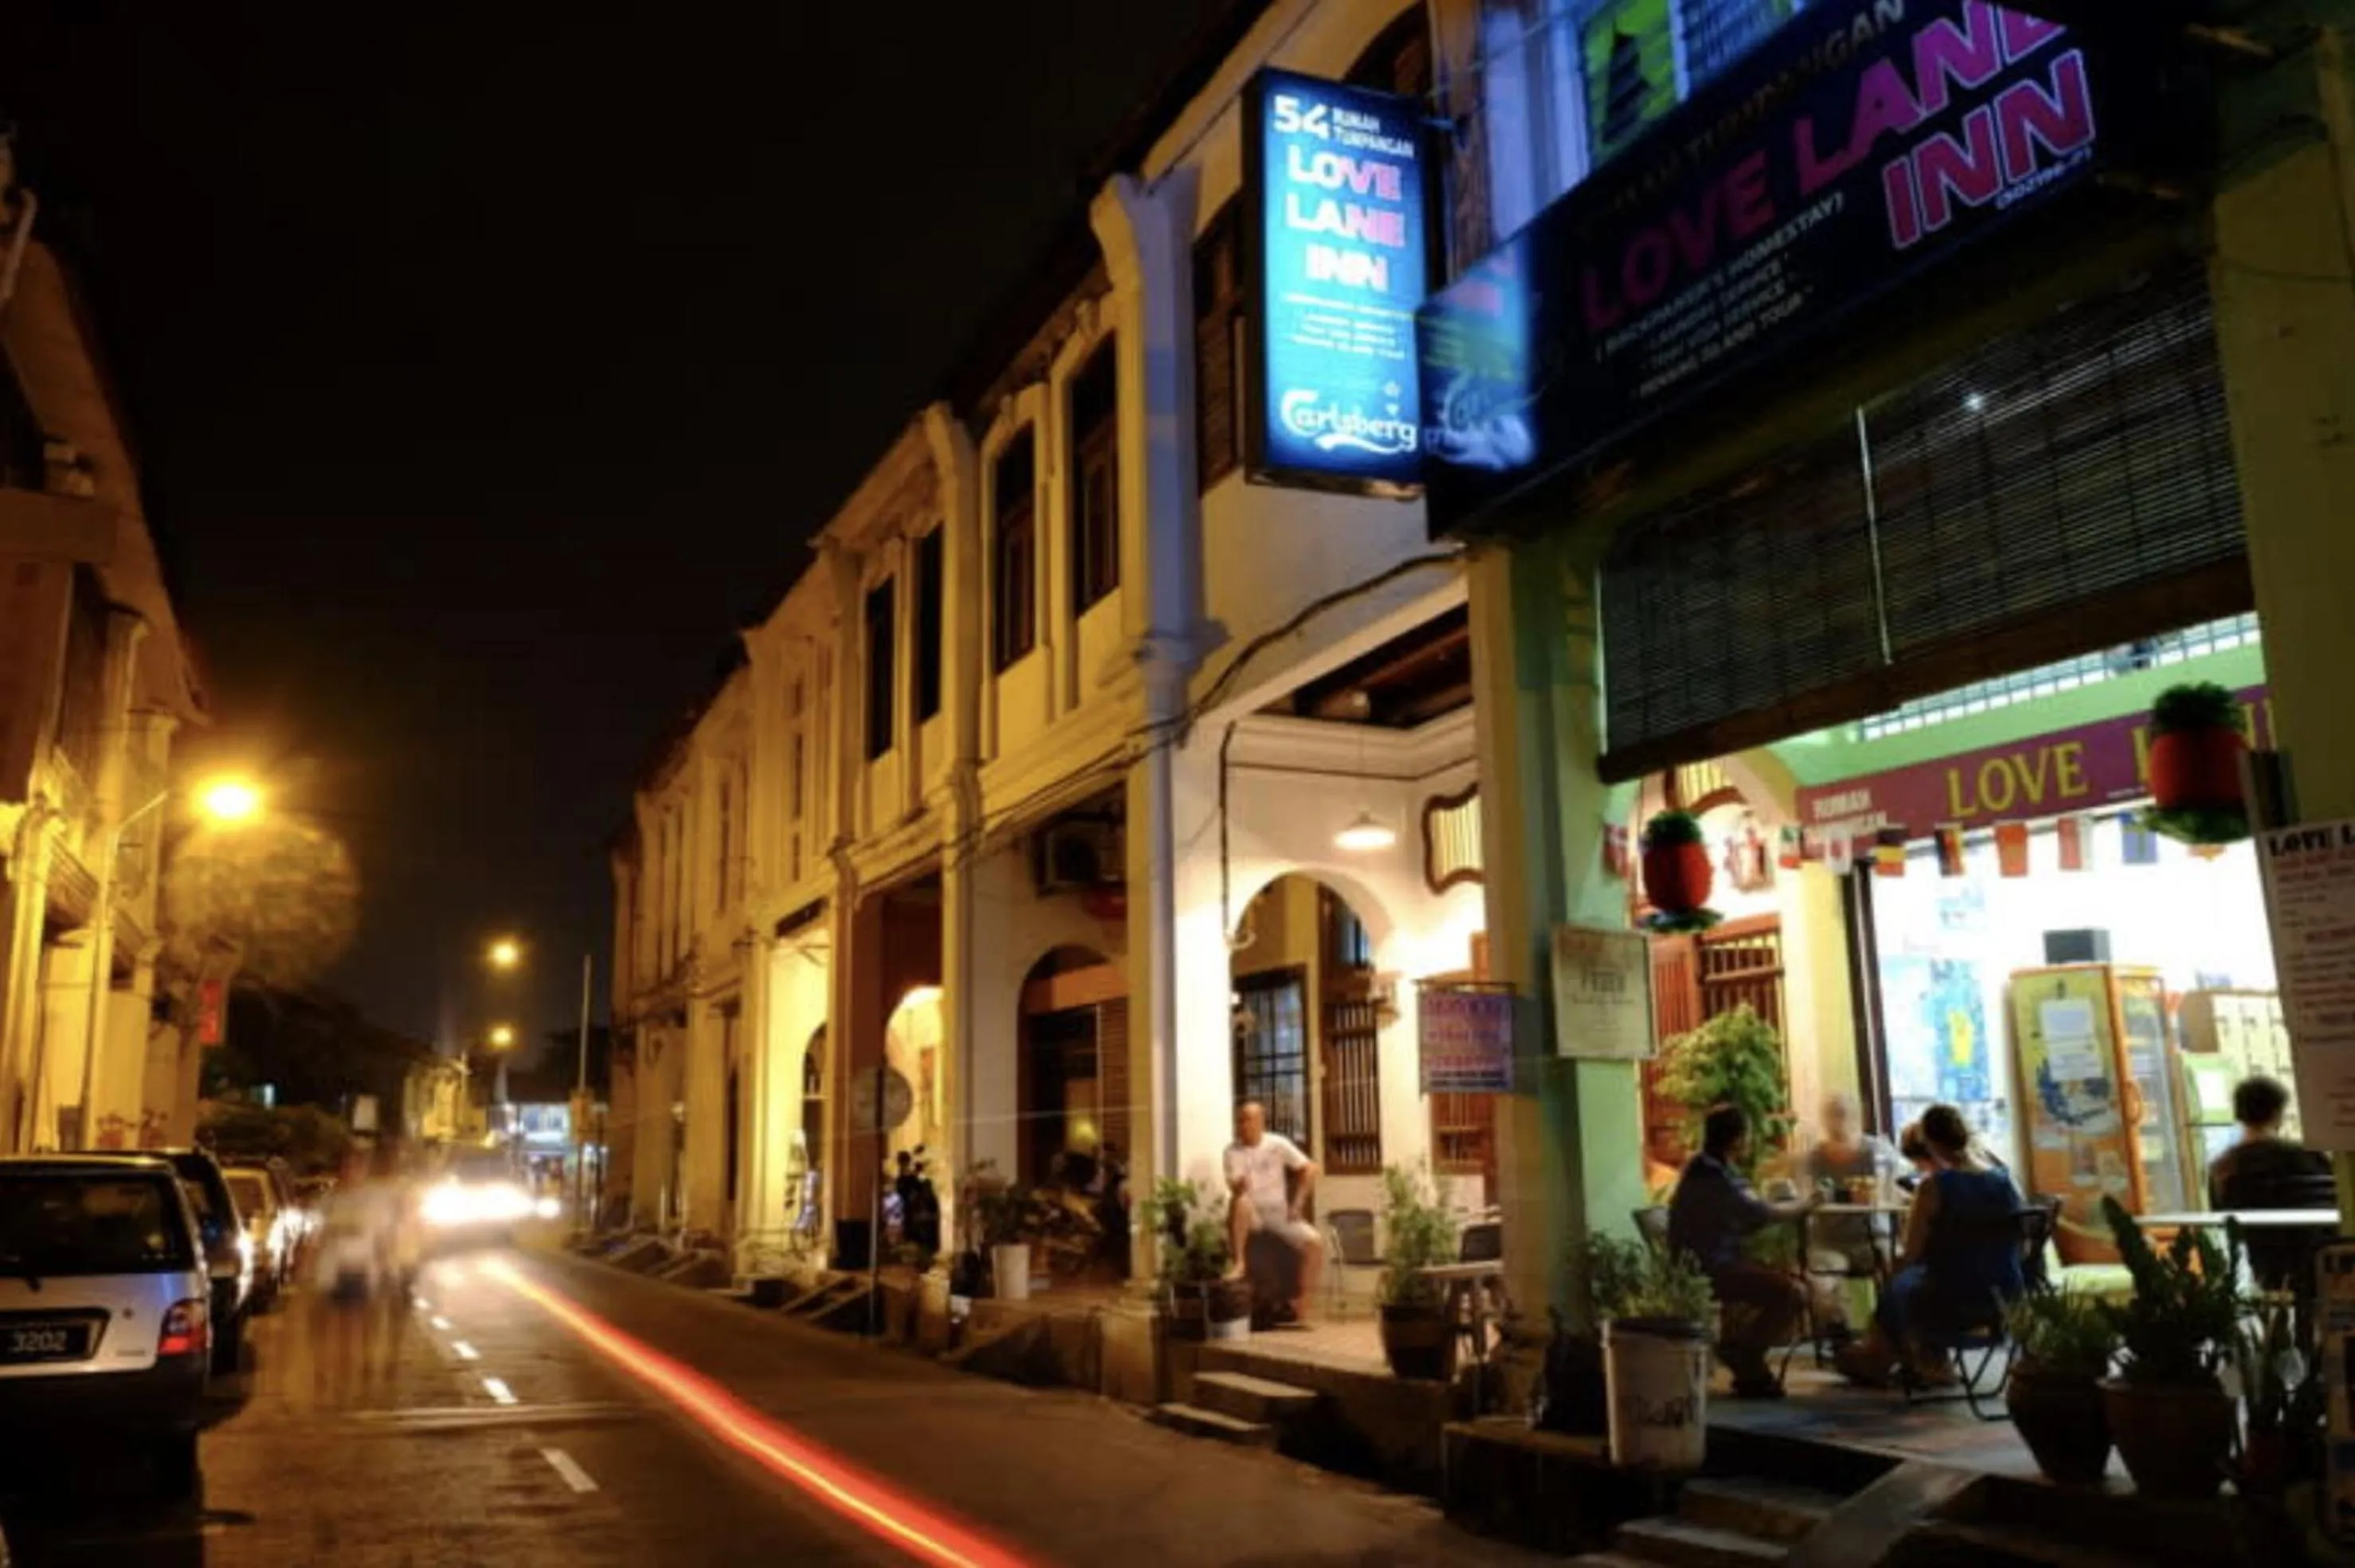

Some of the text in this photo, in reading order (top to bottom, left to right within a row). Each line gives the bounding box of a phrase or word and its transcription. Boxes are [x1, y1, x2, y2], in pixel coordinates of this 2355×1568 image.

[1275, 95, 1330, 140] 54
[1288, 143, 1402, 200] LOVE
[1881, 46, 2097, 250] INN
[1286, 191, 1405, 249] LANE
[1580, 150, 1776, 332] LOVE
[1306, 243, 1388, 292] INN
[1280, 389, 1417, 453] Carlsberg
[1948, 740, 2089, 819] LOVE
[2268, 828, 2333, 858] LOVE
